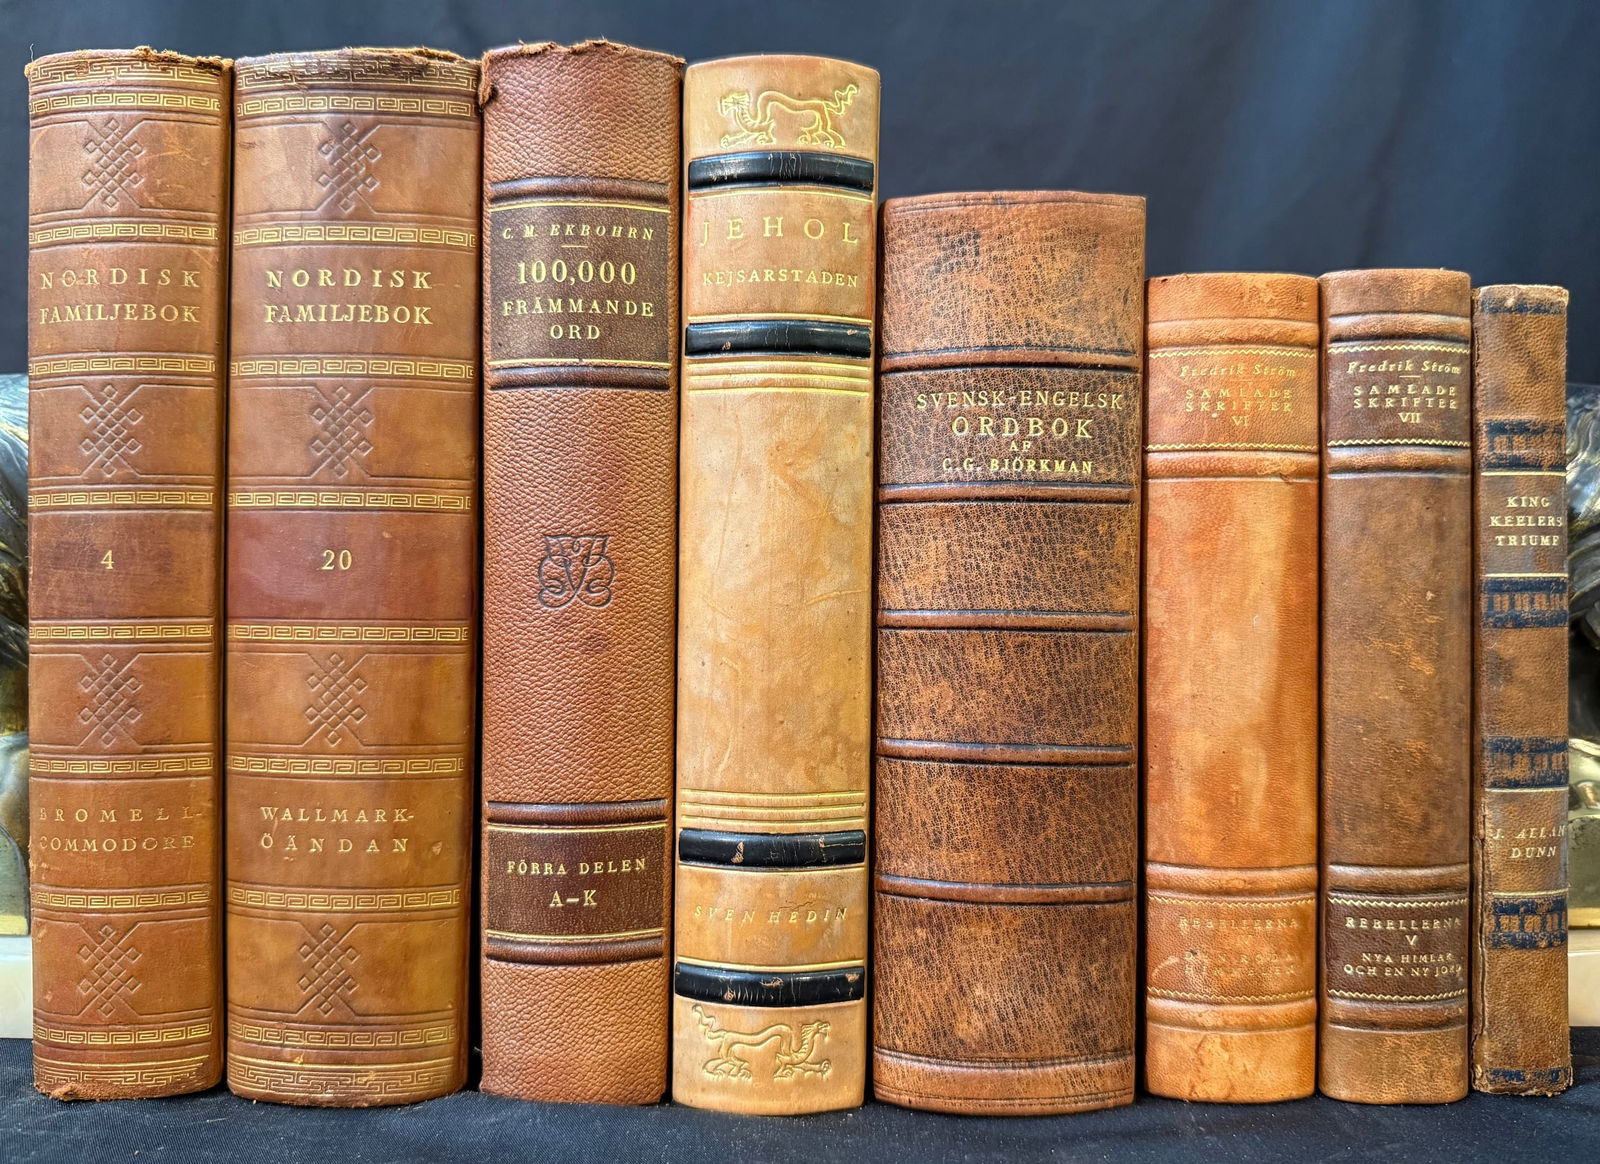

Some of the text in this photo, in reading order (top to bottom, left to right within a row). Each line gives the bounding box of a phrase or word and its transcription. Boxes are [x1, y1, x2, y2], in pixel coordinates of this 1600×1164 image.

[503, 224, 654, 240] C. M. EKBOHRN
[700, 216, 858, 246] JEHOL
[40, 269, 200, 290] NORDISK
[265, 269, 433, 290] NORDISK
[518, 260, 636, 285] 100,000
[703, 269, 858, 287] KEJSARSTADEN
[39, 304, 200, 324] FAMILJEBOK
[264, 305, 434, 325] FAMILJEBOK
[503, 297, 654, 317] FRÄMMANDE
[550, 324, 600, 339] ORD
[1346, 360, 1462, 374] Fredrik Ström
[1185, 388, 1293, 399] SAMLADE
[1353, 384, 1457, 396] SAMLADE
[916, 390, 1123, 409] SVENSK-ENGELSK
[1185, 401, 1293, 412] SKRIFTER
[1353, 397, 1458, 409] SKRIFTER
[1231, 415, 1250, 427] VI
[1398, 412, 1421, 423] VII
[952, 416, 1093, 438] ORDBOK
[1009, 440, 1031, 452] AF
[990, 456, 1093, 474] BJÖRKMAN
[1506, 496, 1551, 508] KING
[1489, 515, 1563, 527] KEELERS
[100, 550, 115, 570] 4
[321, 550, 353, 570] 20
[260, 806, 415, 822] WALLMARK-
[39, 835, 195, 852] COMMODORE
[1509, 846, 1557, 859] DUNN
[507, 858, 646, 875] FÖRRA DELEN
[694, 905, 848, 924] SVEN HEDIN
[1345, 916, 1461, 930] REBELLERNA
[1405, 935, 1418, 945] V
[1362, 953, 1394, 963] NYA
[1343, 964, 1377, 976] OCH
[1384, 967, 1404, 977] EN
[1411, 967, 1429, 977] NY
